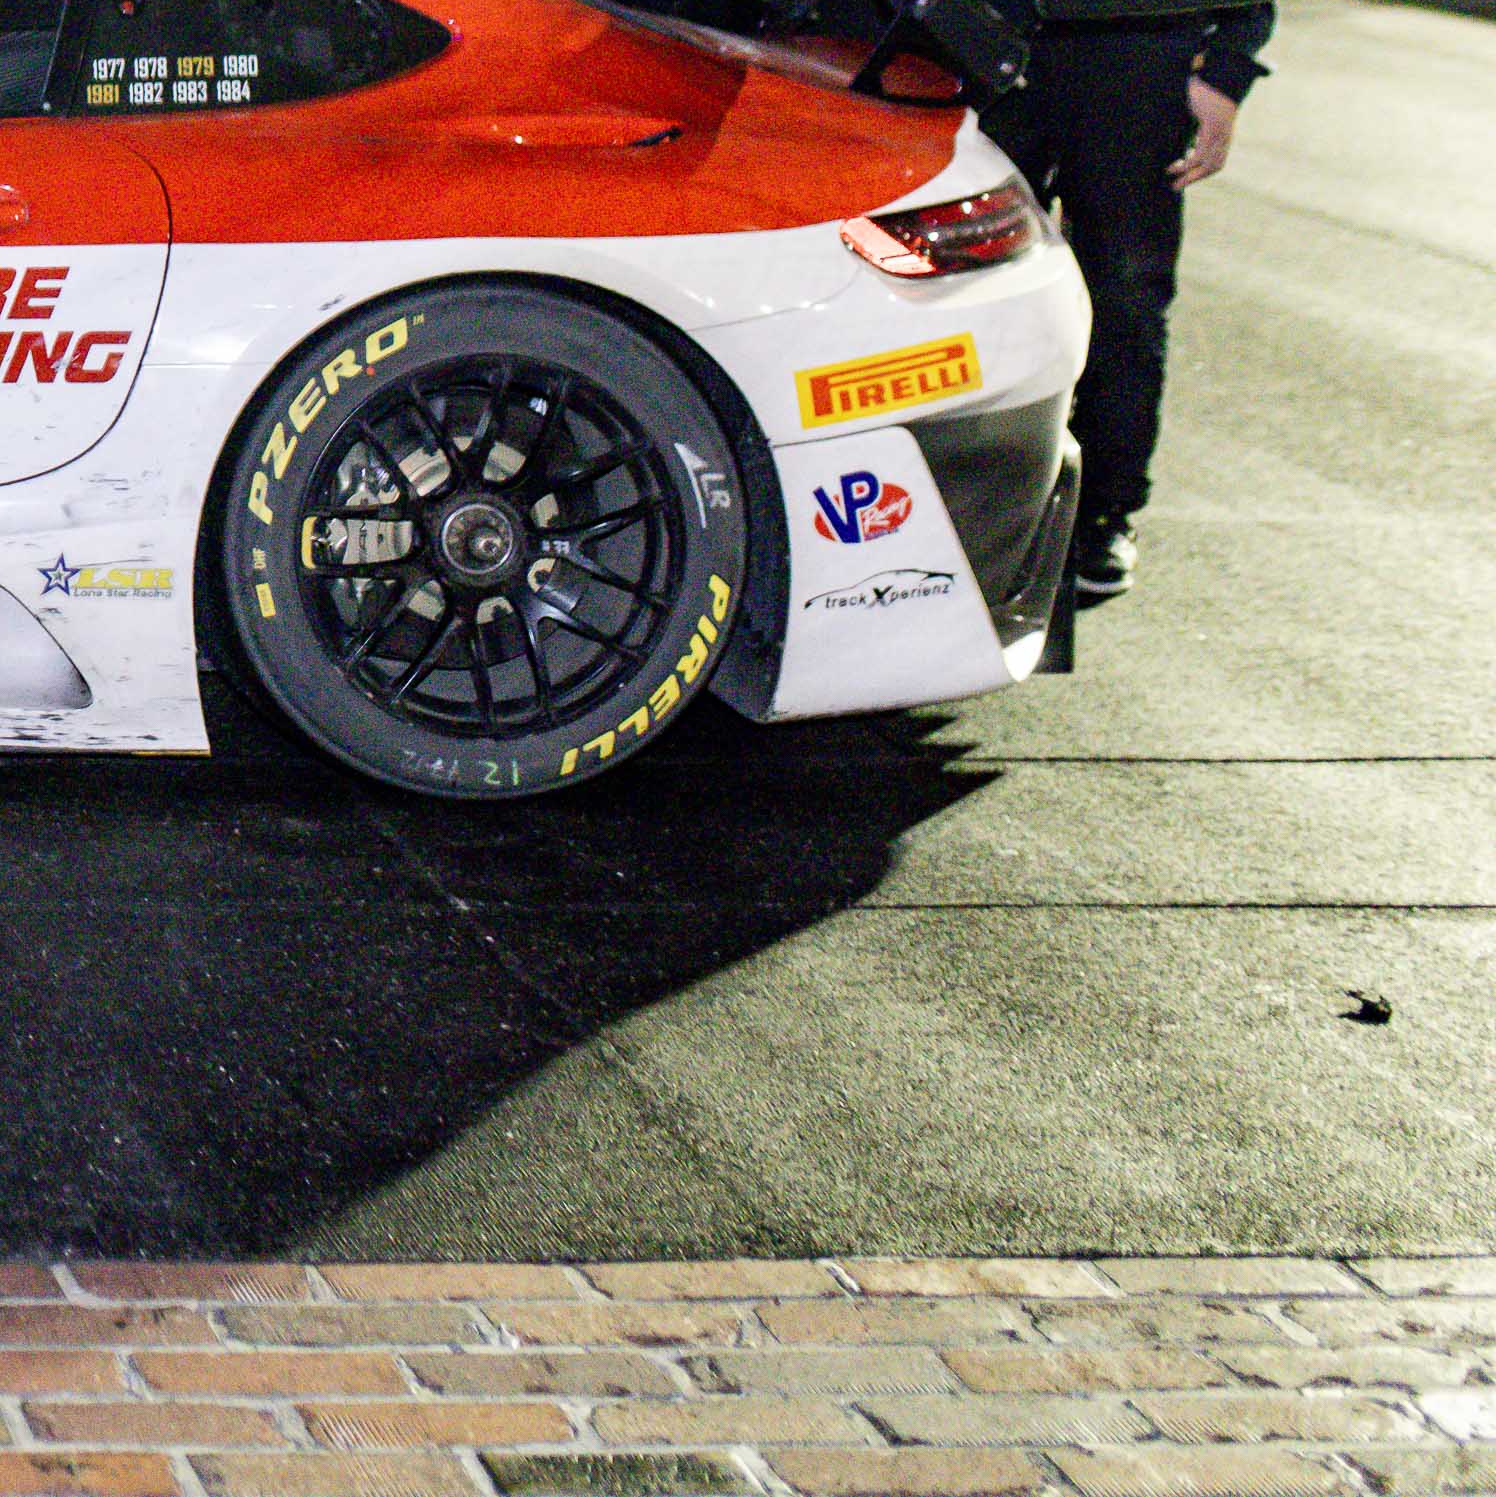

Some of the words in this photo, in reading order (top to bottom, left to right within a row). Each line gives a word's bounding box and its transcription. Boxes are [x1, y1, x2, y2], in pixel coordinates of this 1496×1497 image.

[87, 84, 120, 105] 1981
[128, 82, 164, 105] 1982
[172, 80, 208, 103] 1983
[217, 80, 251, 103] 1984
[93, 57, 125, 81] 1977
[134, 56, 168, 80] 1978
[177, 56, 214, 78] 1979
[223, 55, 258, 78] 1980
[810, 343, 970, 417] PIRELLI
[813, 471, 879, 543] VP
[77, 567, 174, 589] LSR
[560, 574, 731, 776] PIRELLI
